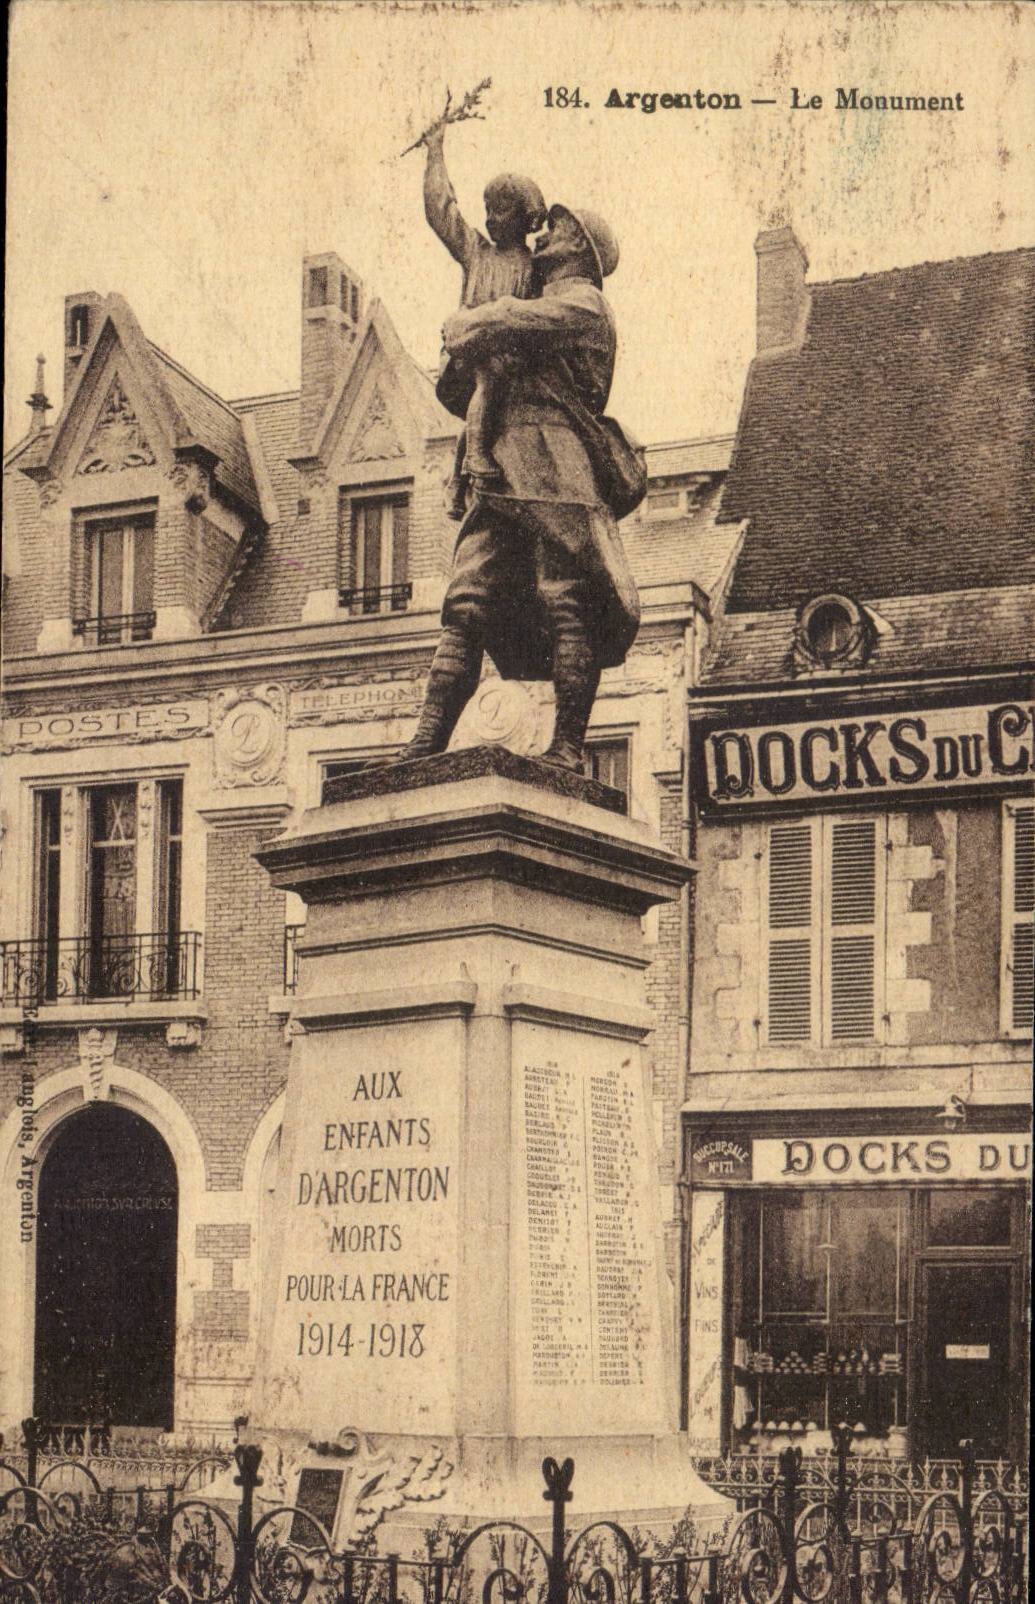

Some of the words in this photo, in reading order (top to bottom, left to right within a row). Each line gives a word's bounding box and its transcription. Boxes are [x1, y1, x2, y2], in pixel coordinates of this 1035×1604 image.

[18, 705, 191, 739] POSTES
[712, 717, 930, 800] DOCKS
[933, 733, 985, 781] DU
[352, 1070, 402, 1101] AUX
[323, 1117, 431, 1151] ENFANTS
[780, 1140, 951, 1176] DOCKS
[978, 1144, 1030, 1172] DU
[296, 1165, 450, 1206] D'ARGENTON
[330, 1223, 402, 1252] MORTS
[371, 1272, 450, 1302] FRANCE
[694, 1281, 719, 1299] VINS
[297, 1321, 426, 1358] 1914-1918
[695, 1319, 719, 1333] FINS
